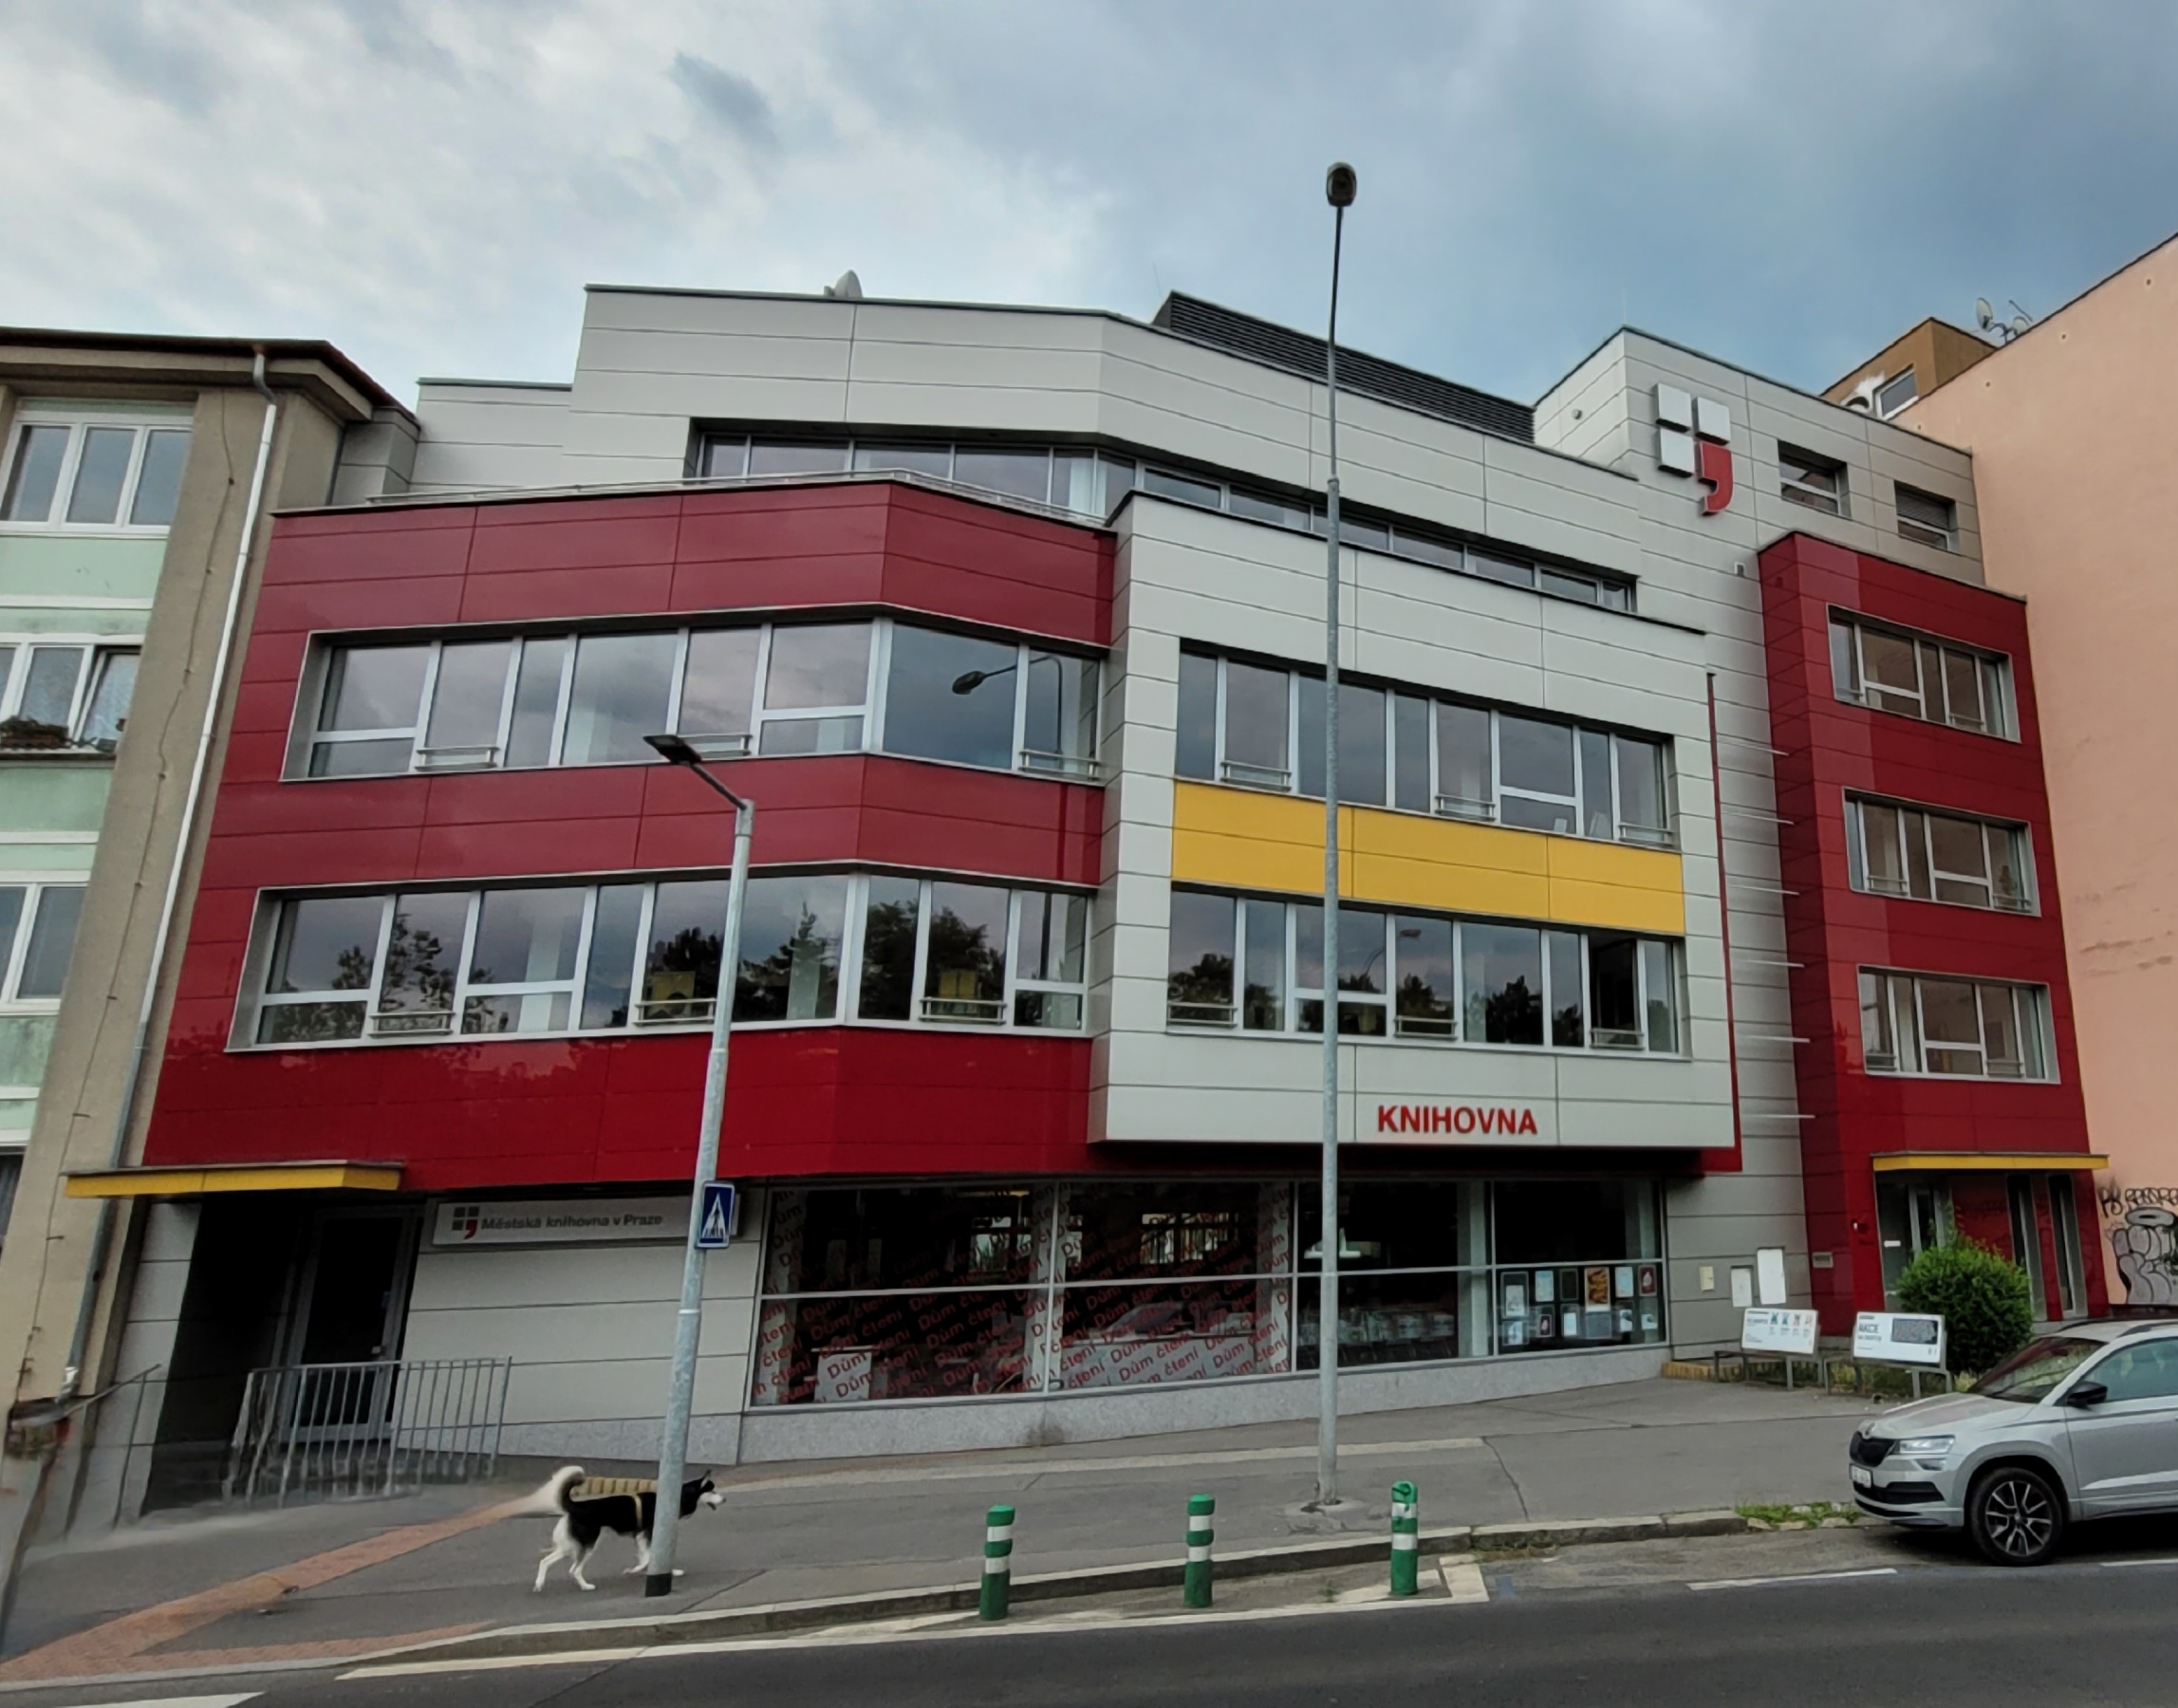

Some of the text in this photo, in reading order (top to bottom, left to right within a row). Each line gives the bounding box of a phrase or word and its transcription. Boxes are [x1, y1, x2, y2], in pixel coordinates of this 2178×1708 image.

[1378, 1105, 1537, 1135] KNIHOVNA
[481, 1217, 541, 1230] Městská
[546, 1216, 610, 1228] knihovna
[624, 1214, 662, 1226] Praze
[1085, 1285, 1123, 1311] Dům
[810, 1313, 850, 1342] Dům
[1093, 1300, 1130, 1327] Dům
[763, 1335, 804, 1366] čtení
[863, 1308, 903, 1336] čtení
[771, 1357, 811, 1385] čtení
[828, 1351, 867, 1379] Dům
[917, 1303, 957, 1331] Dům
[836, 1371, 874, 1398] Dům
[925, 1322, 965, 1348] Dům
[967, 1296, 1008, 1326] čtení
[1213, 1343, 1245, 1368] Dům
[1248, 1316, 1280, 1346] čtení
[1256, 1332, 1289, 1363] čtení
[935, 1341, 974, 1368] Dům
[1060, 1342, 1097, 1371] čtení
[1068, 1358, 1106, 1388] čtení
[1110, 1340, 1146, 1364] Dům
[1119, 1355, 1154, 1382] Dům
[1156, 1331, 1192, 1359] čtení
[1164, 1346, 1200, 1376] čtení
[943, 1359, 980, 1386] Dům
